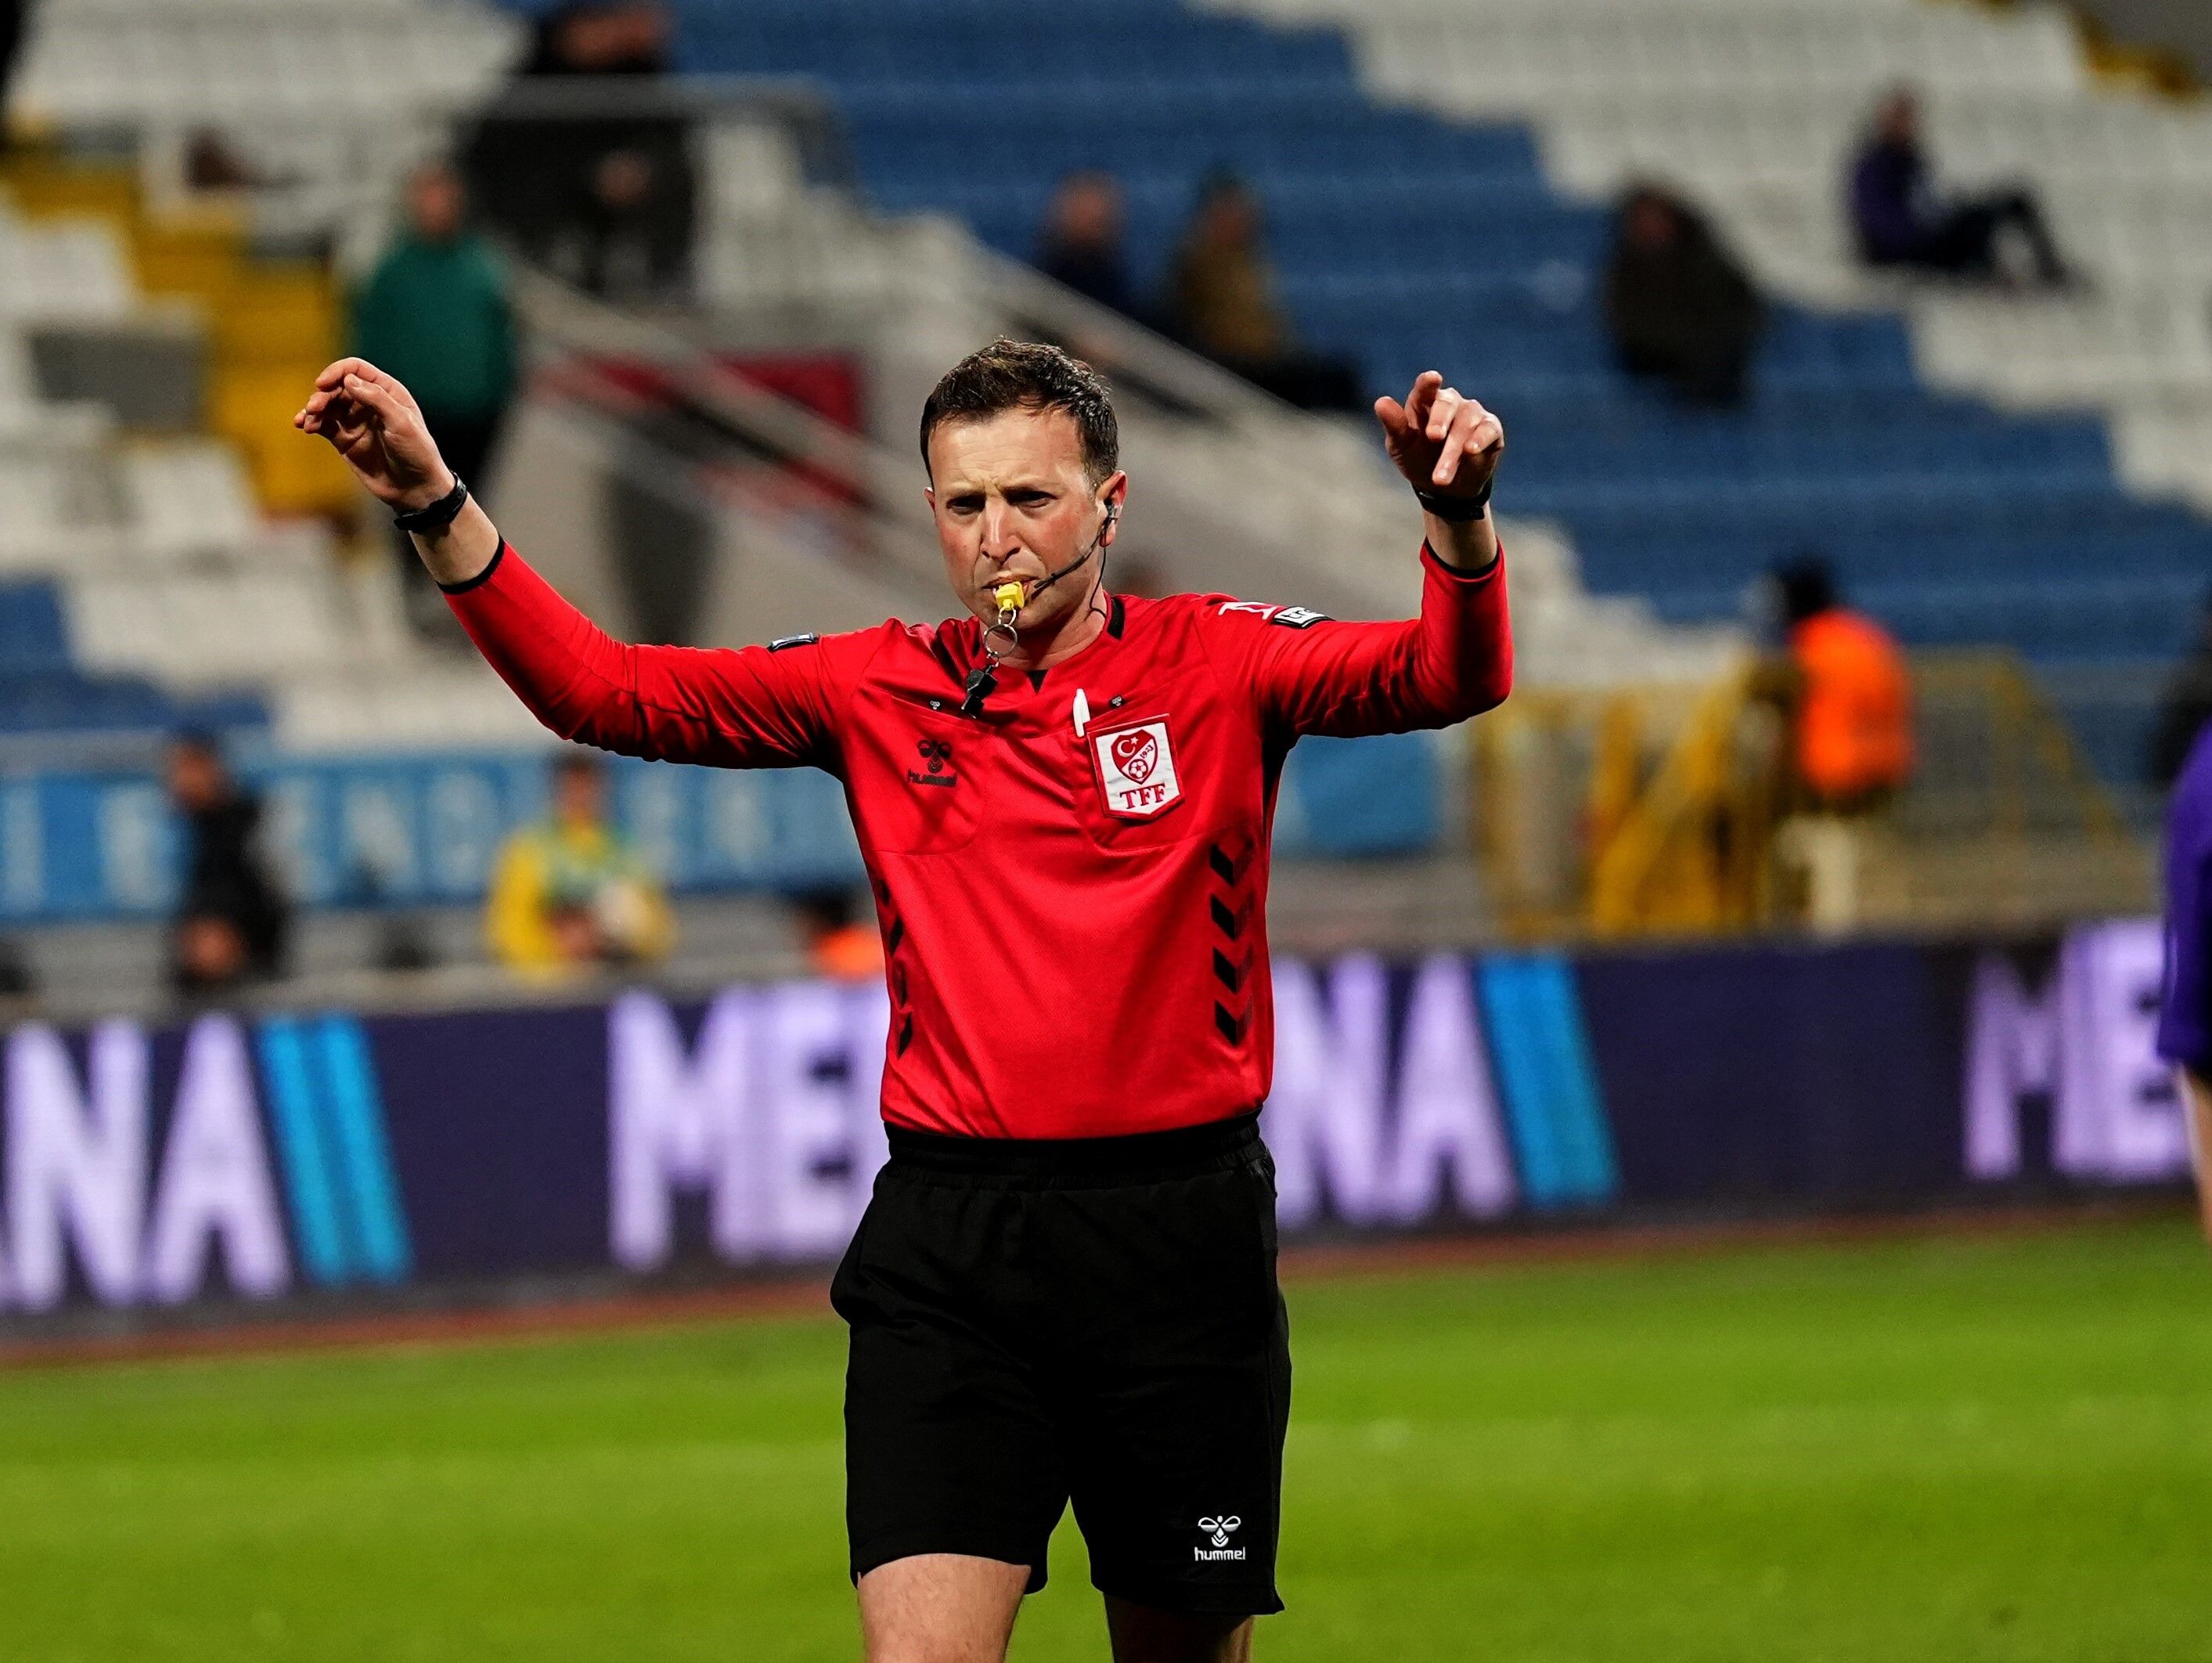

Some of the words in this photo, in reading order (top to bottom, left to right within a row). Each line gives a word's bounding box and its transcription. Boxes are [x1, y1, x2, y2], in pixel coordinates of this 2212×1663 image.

[1119, 783, 1166, 810] TFF
[0, 1014, 291, 1314] NA
[1194, 1546, 1245, 1561] hummel
